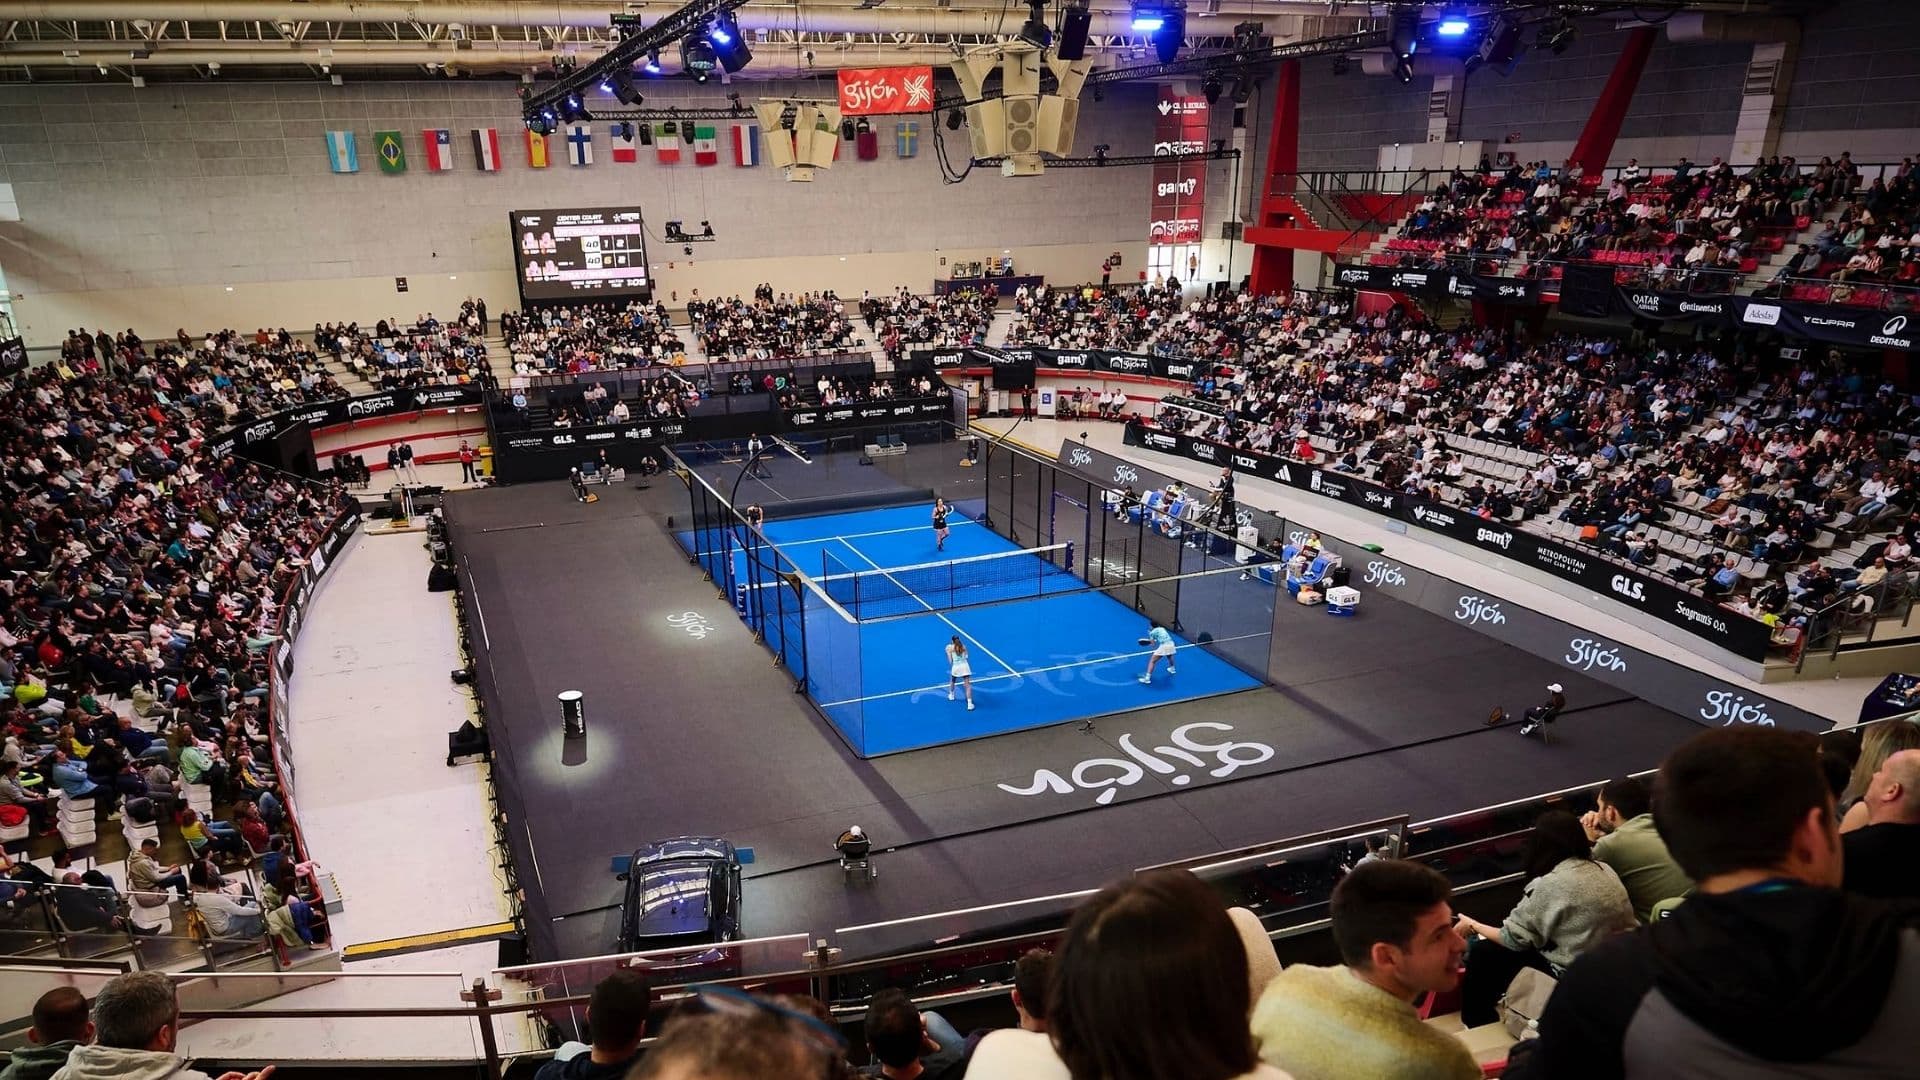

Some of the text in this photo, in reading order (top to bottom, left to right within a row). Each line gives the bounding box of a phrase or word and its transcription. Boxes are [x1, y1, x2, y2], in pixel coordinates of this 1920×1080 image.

[844, 77, 899, 109] gijón
[586, 240, 599, 248] 40
[1633, 294, 1660, 305] QATAR
[1680, 301, 1717, 312] Continental
[1811, 317, 1856, 329] CUPRA
[1870, 335, 1911, 348] DECATHLON
[1069, 447, 1092, 467] gijón
[1192, 442, 1215, 454] QATAR
[1113, 464, 1138, 485] gijón
[1537, 547, 1586, 570] METROPOLITAN
[1364, 560, 1406, 588] gijón
[1455, 595, 1506, 625] gijón
[1675, 600, 1713, 627] Seagram's
[1565, 638, 1627, 673] gijón
[1700, 690, 1775, 728] gijón
[996, 722, 1275, 805] gijón
